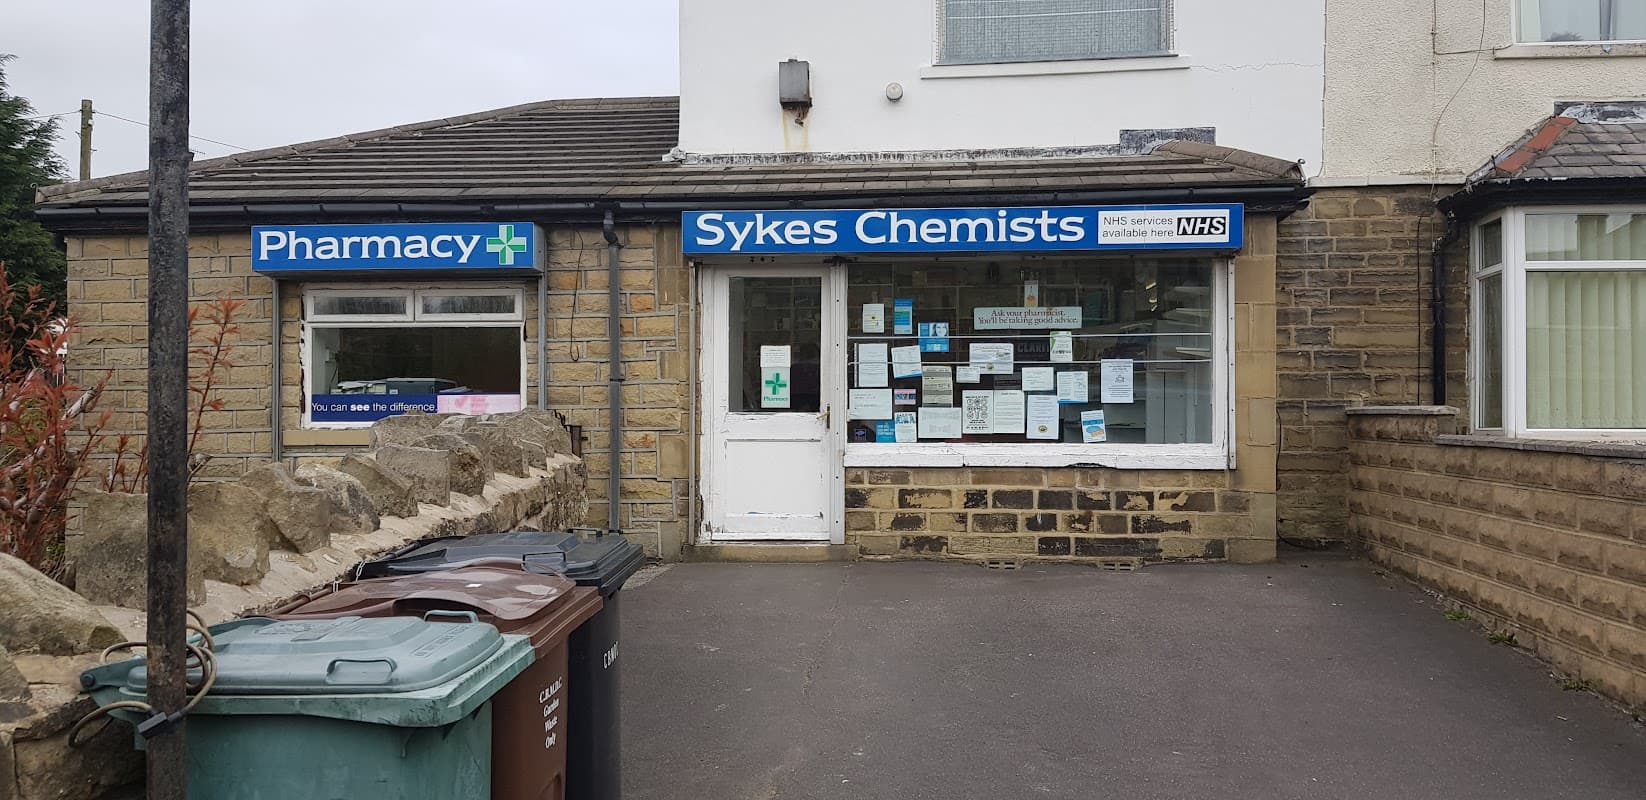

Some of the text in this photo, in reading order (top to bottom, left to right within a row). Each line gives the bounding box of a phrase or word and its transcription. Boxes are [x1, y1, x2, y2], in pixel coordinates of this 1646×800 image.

[1103, 216, 1173, 226] NHS services
[696, 210, 1086, 251] Sykes Chemists
[1177, 217, 1226, 236] NHS
[1102, 228, 1174, 238] available here
[258, 230, 481, 263] Pharmacy
[1024, 309, 1066, 318] pharmacist.
[1008, 317, 1033, 325] taking
[1034, 317, 1053, 326] good
[312, 402, 438, 412] You can see the difference.
[545, 732, 557, 749] Only
